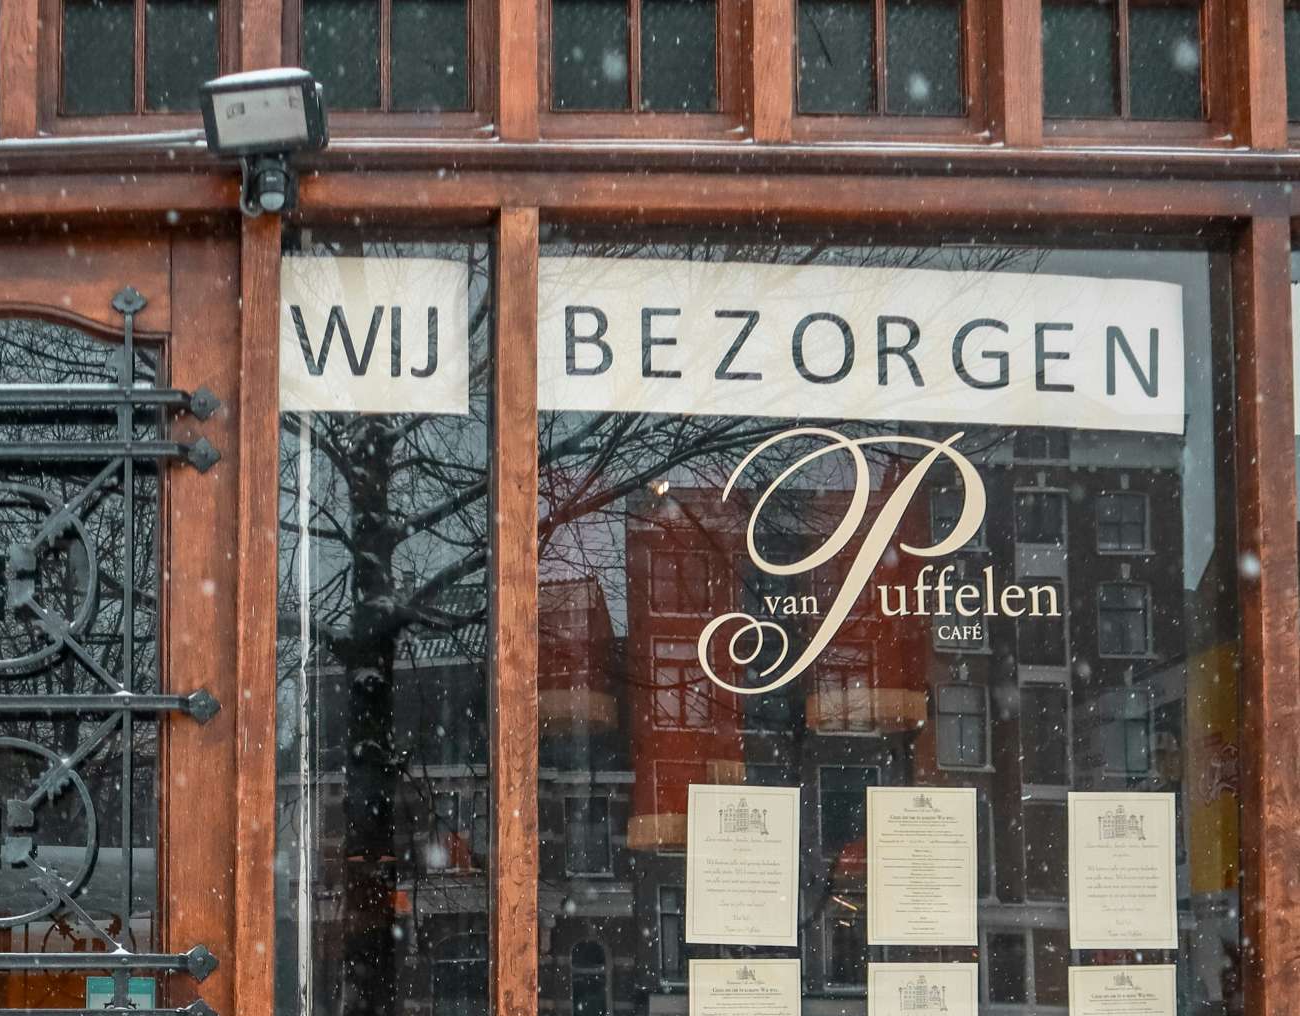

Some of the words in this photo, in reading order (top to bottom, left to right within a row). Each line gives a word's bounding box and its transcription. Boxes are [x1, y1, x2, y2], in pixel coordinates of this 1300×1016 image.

[289, 304, 440, 379] WIJ
[565, 305, 1161, 399] BEZORGEN
[698, 427, 1061, 695] Puffelen
[764, 596, 820, 615] van
[938, 623, 983, 641] CAFÉ
